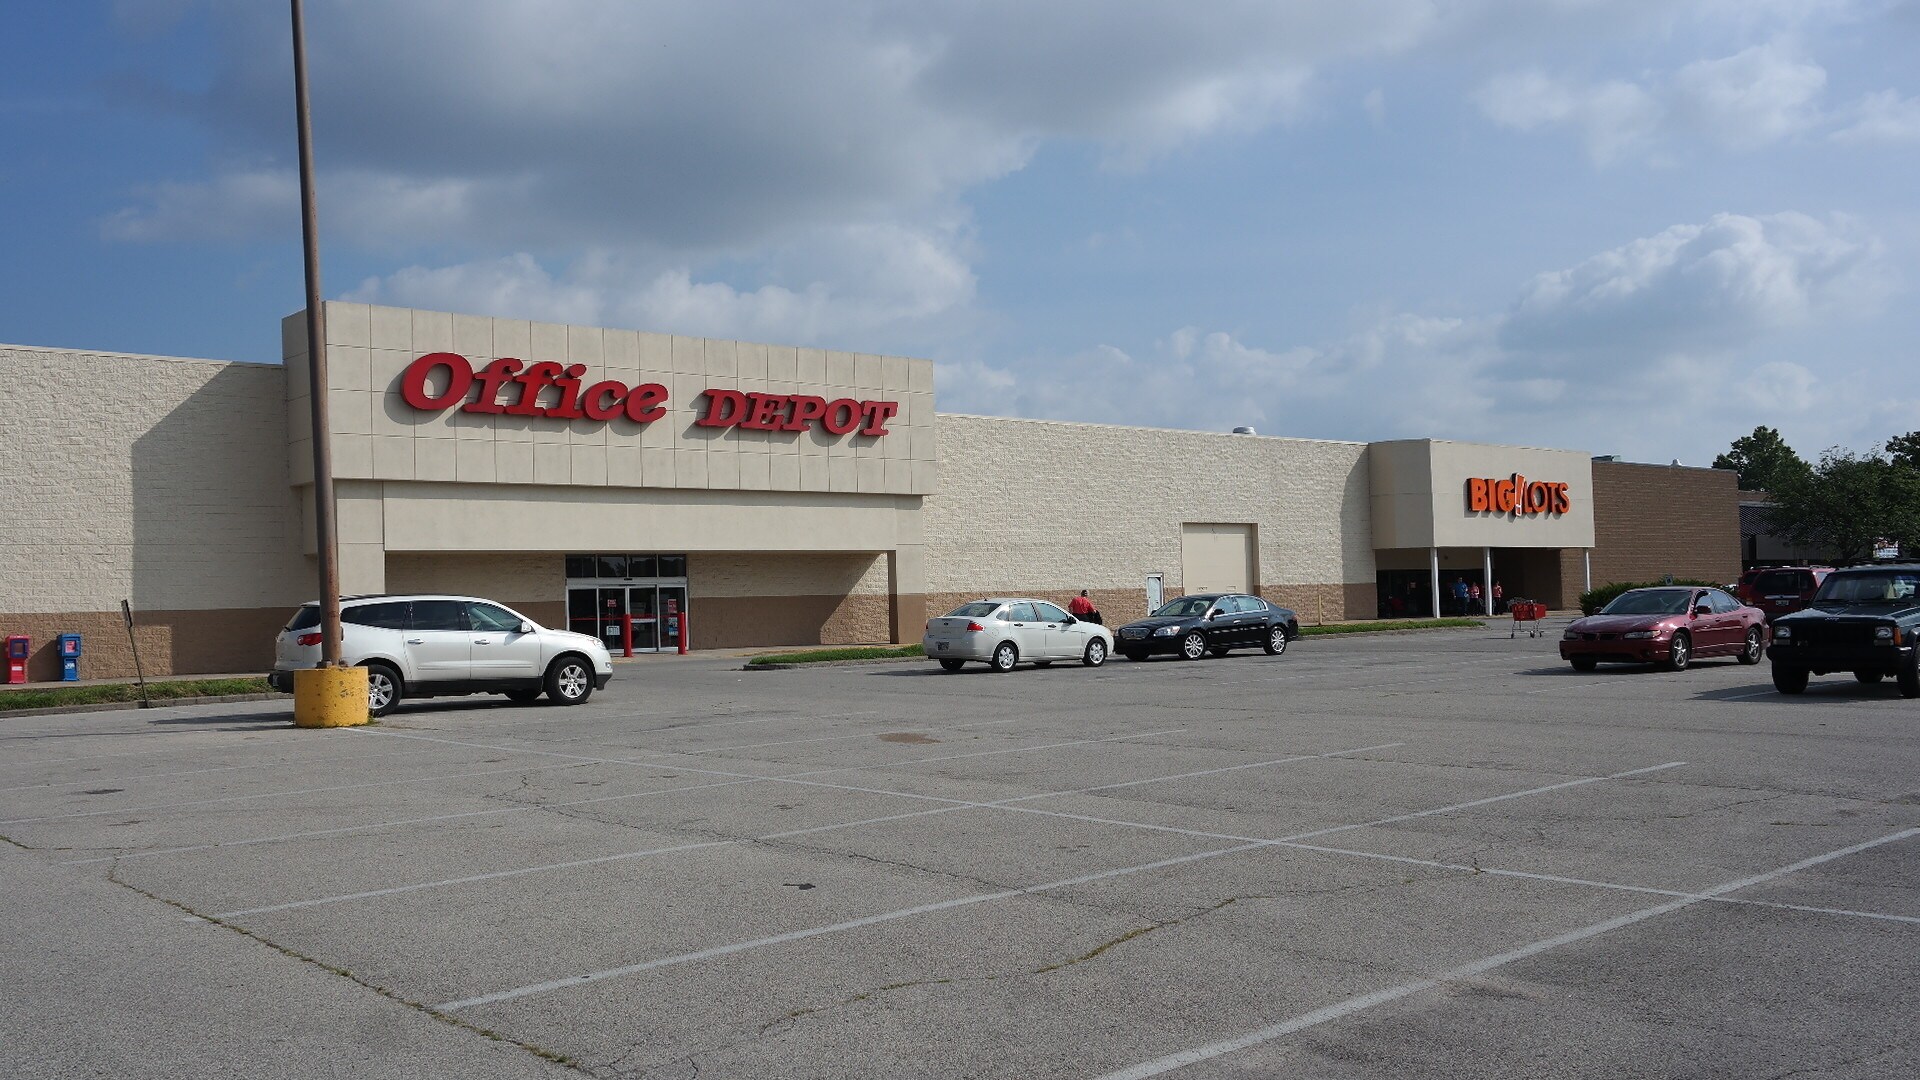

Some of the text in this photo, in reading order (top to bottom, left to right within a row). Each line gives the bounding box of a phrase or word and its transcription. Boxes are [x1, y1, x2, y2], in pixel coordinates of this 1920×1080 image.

[402, 352, 899, 436] Office DEPOT
[1523, 480, 1570, 514] LOTS
